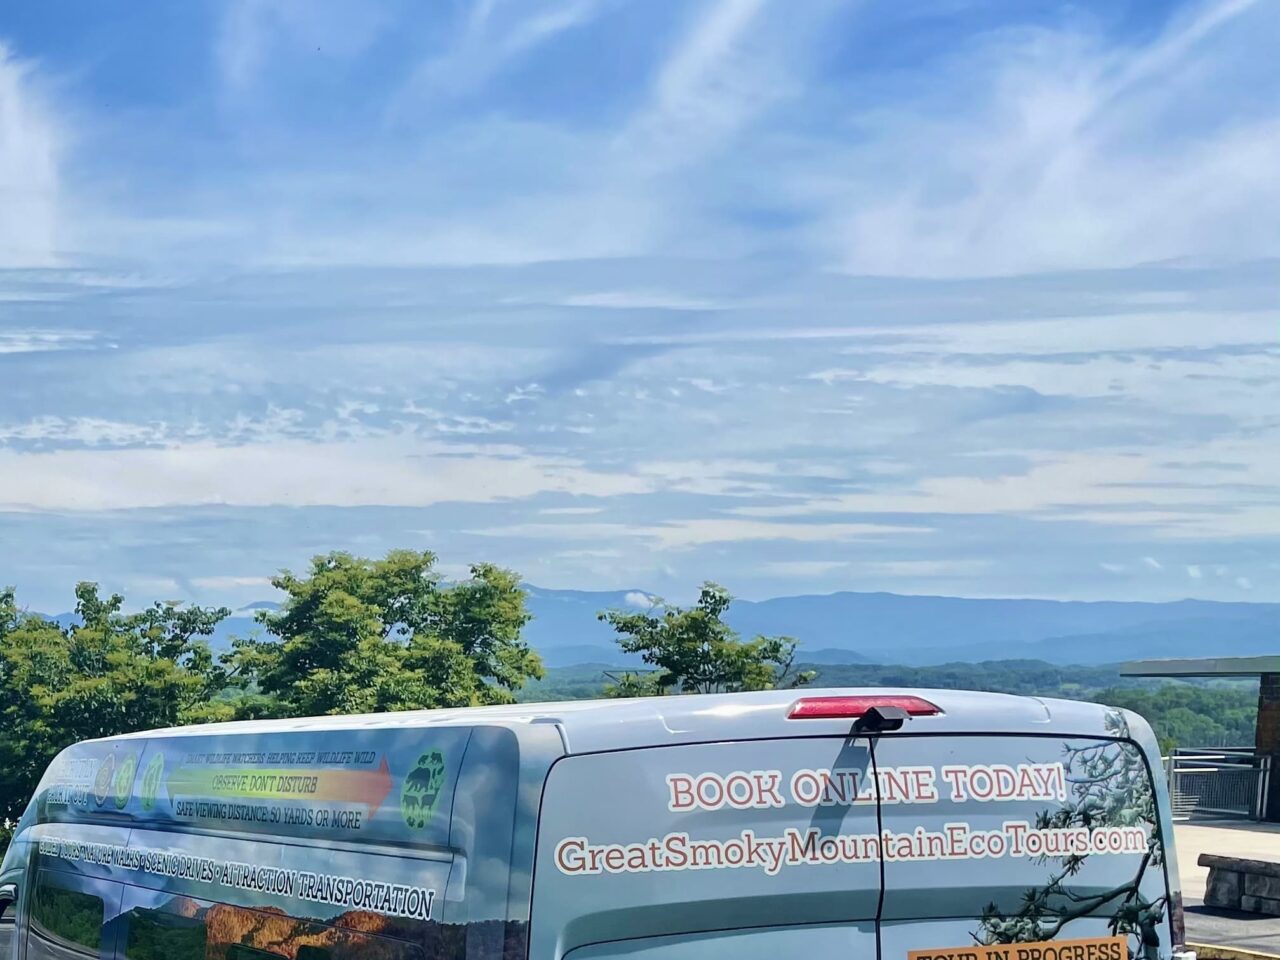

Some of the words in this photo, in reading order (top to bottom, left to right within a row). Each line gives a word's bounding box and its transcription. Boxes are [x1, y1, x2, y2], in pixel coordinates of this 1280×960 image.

[266, 752, 295, 764] HELPING
[296, 752, 316, 764] KEEP
[317, 752, 353, 764] WILDLIFE
[354, 752, 376, 764] WILD
[249, 775, 275, 792] DON'T
[277, 776, 318, 793] DISTURB
[669, 774, 782, 809] BOOK
[793, 770, 934, 803] ONLINE
[945, 766, 1065, 799] TODAY!
[176, 801, 194, 816] SAFE
[195, 803, 227, 819] VIEWING
[283, 807, 314, 826] YARDS
[315, 809, 329, 827] OR
[331, 810, 362, 829] MORE
[557, 824, 1147, 872] GreatSmokyMountainEcoTours.com
[60, 839, 81, 861] TOURS
[84, 842, 112, 865] NATURE
[113, 845, 140, 870] WALKS
[144, 853, 179, 878] SCENIC
[179, 858, 214, 882] DRIVES
[220, 863, 296, 896] ATTRACTION
[298, 873, 435, 919] TRANSPORTATION
